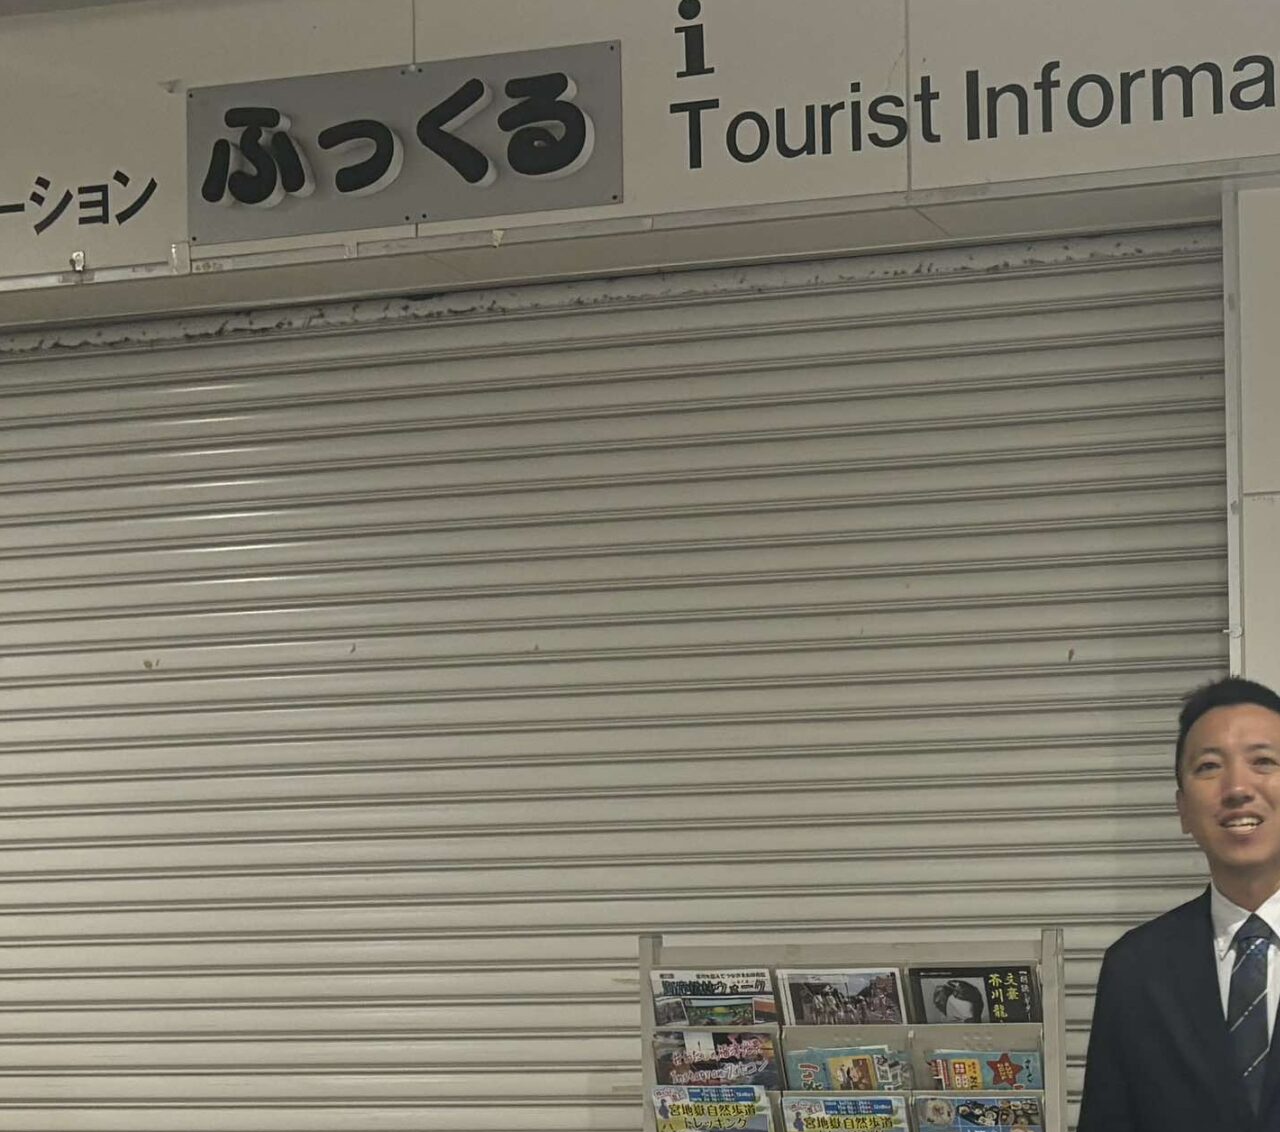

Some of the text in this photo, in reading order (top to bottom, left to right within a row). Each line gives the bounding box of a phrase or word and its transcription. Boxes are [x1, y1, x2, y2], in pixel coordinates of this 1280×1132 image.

[202, 72, 592, 207] ふっくる
[670, 75, 940, 169] Tourist
[0, 170, 157, 235] ーション
